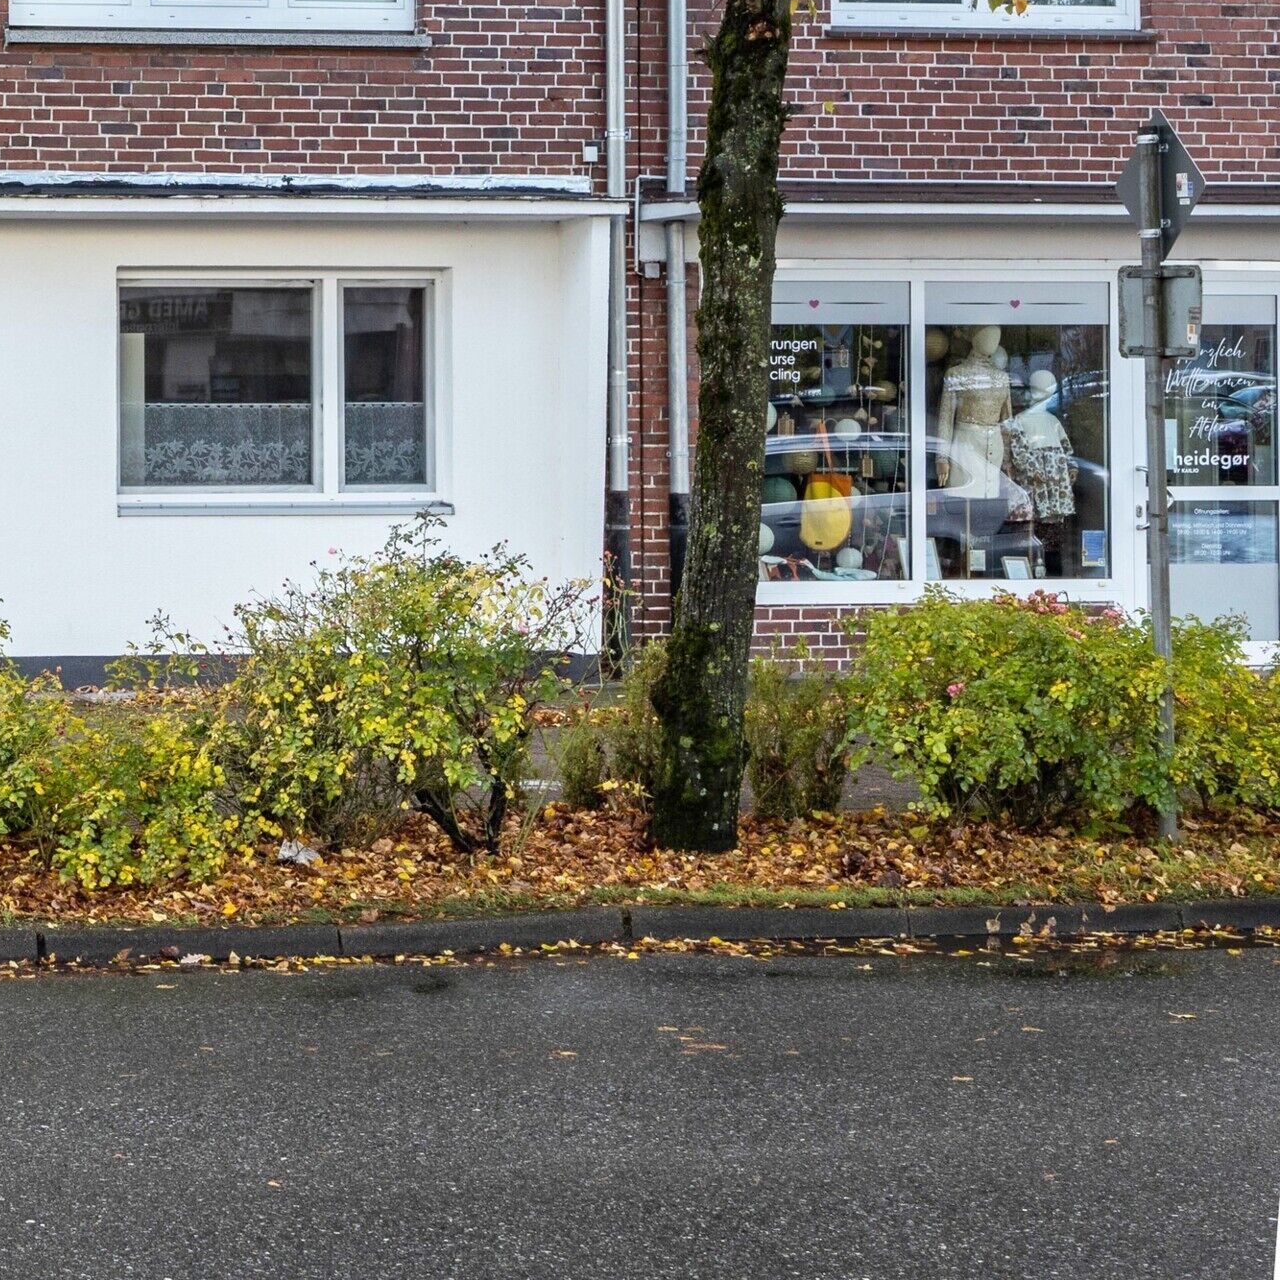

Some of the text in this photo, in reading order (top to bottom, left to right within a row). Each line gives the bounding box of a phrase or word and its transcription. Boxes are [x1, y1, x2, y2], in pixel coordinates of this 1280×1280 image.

[770, 340, 817, 352] rungen
[1177, 336, 1246, 367] rzlich
[770, 355, 795, 365] urse
[770, 368, 800, 383] cling
[1166, 361, 1255, 397] Willkommen
[1201, 399, 1222, 410] im
[1190, 415, 1233, 441] Atelier
[1173, 448, 1250, 470] heidegør
